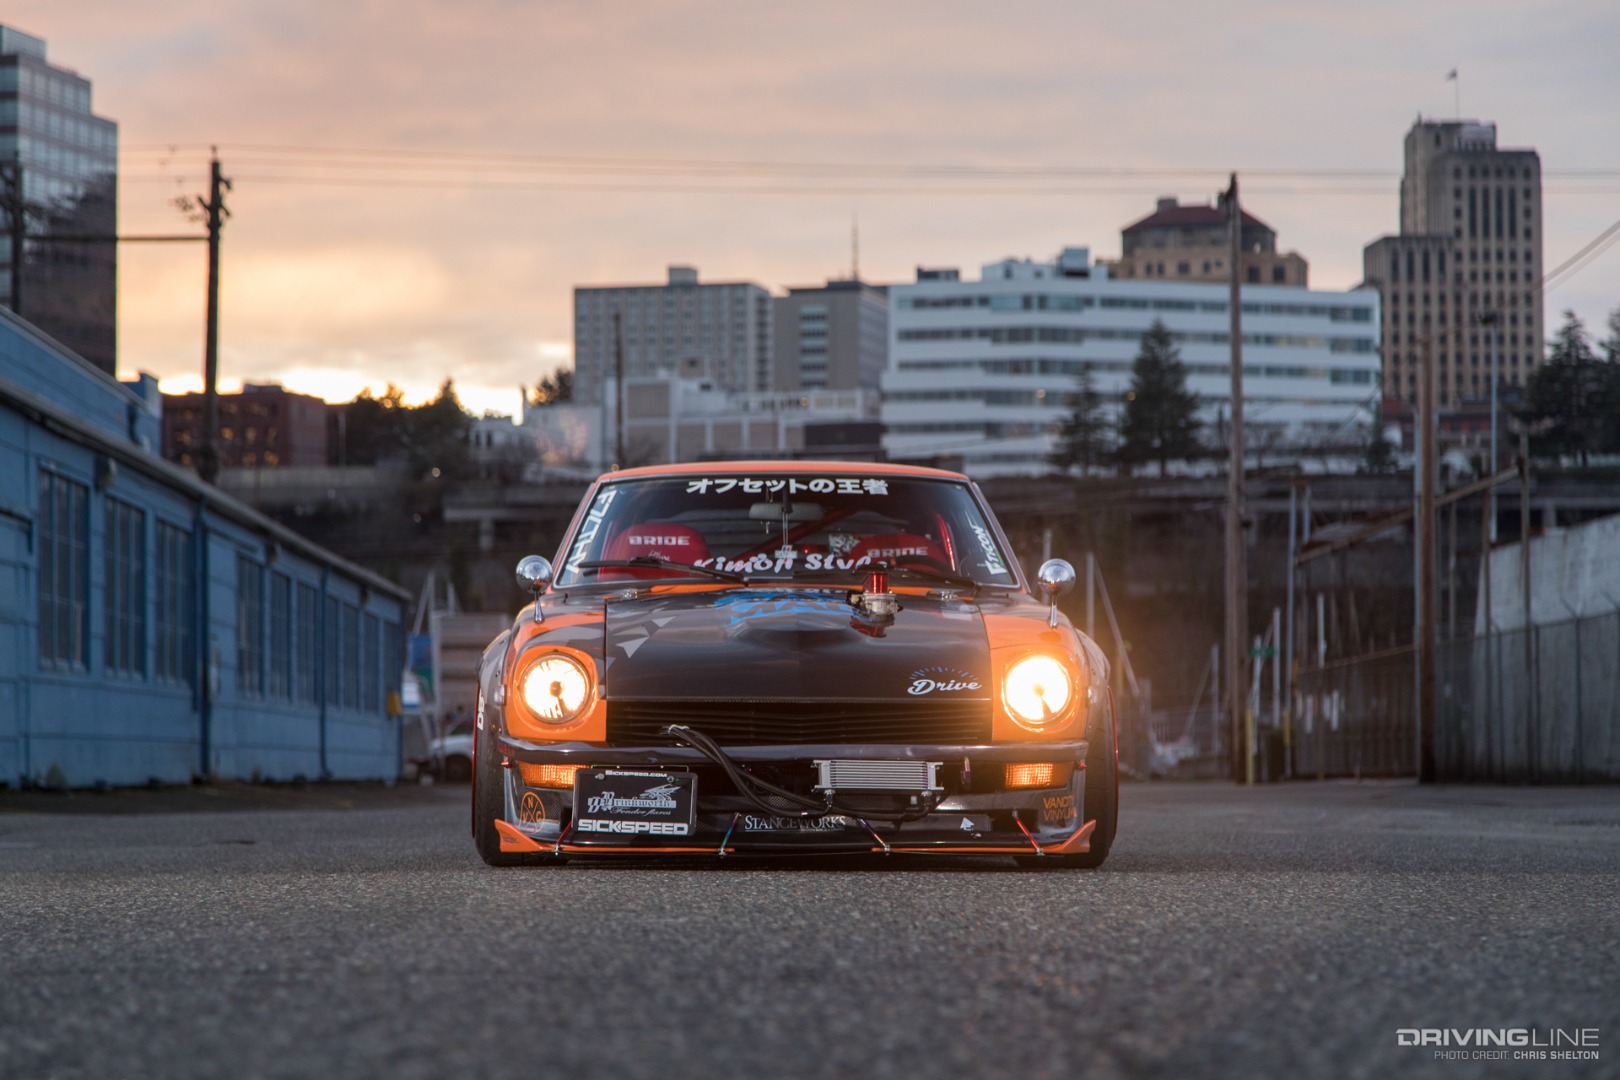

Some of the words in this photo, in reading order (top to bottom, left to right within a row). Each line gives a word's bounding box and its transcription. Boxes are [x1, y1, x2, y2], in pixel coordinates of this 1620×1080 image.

[686, 478, 889, 495] オフセットの王者
[628, 535, 691, 546] BRIDE
[907, 679, 982, 696] Drive
[577, 818, 688, 836] SICKSPEED
